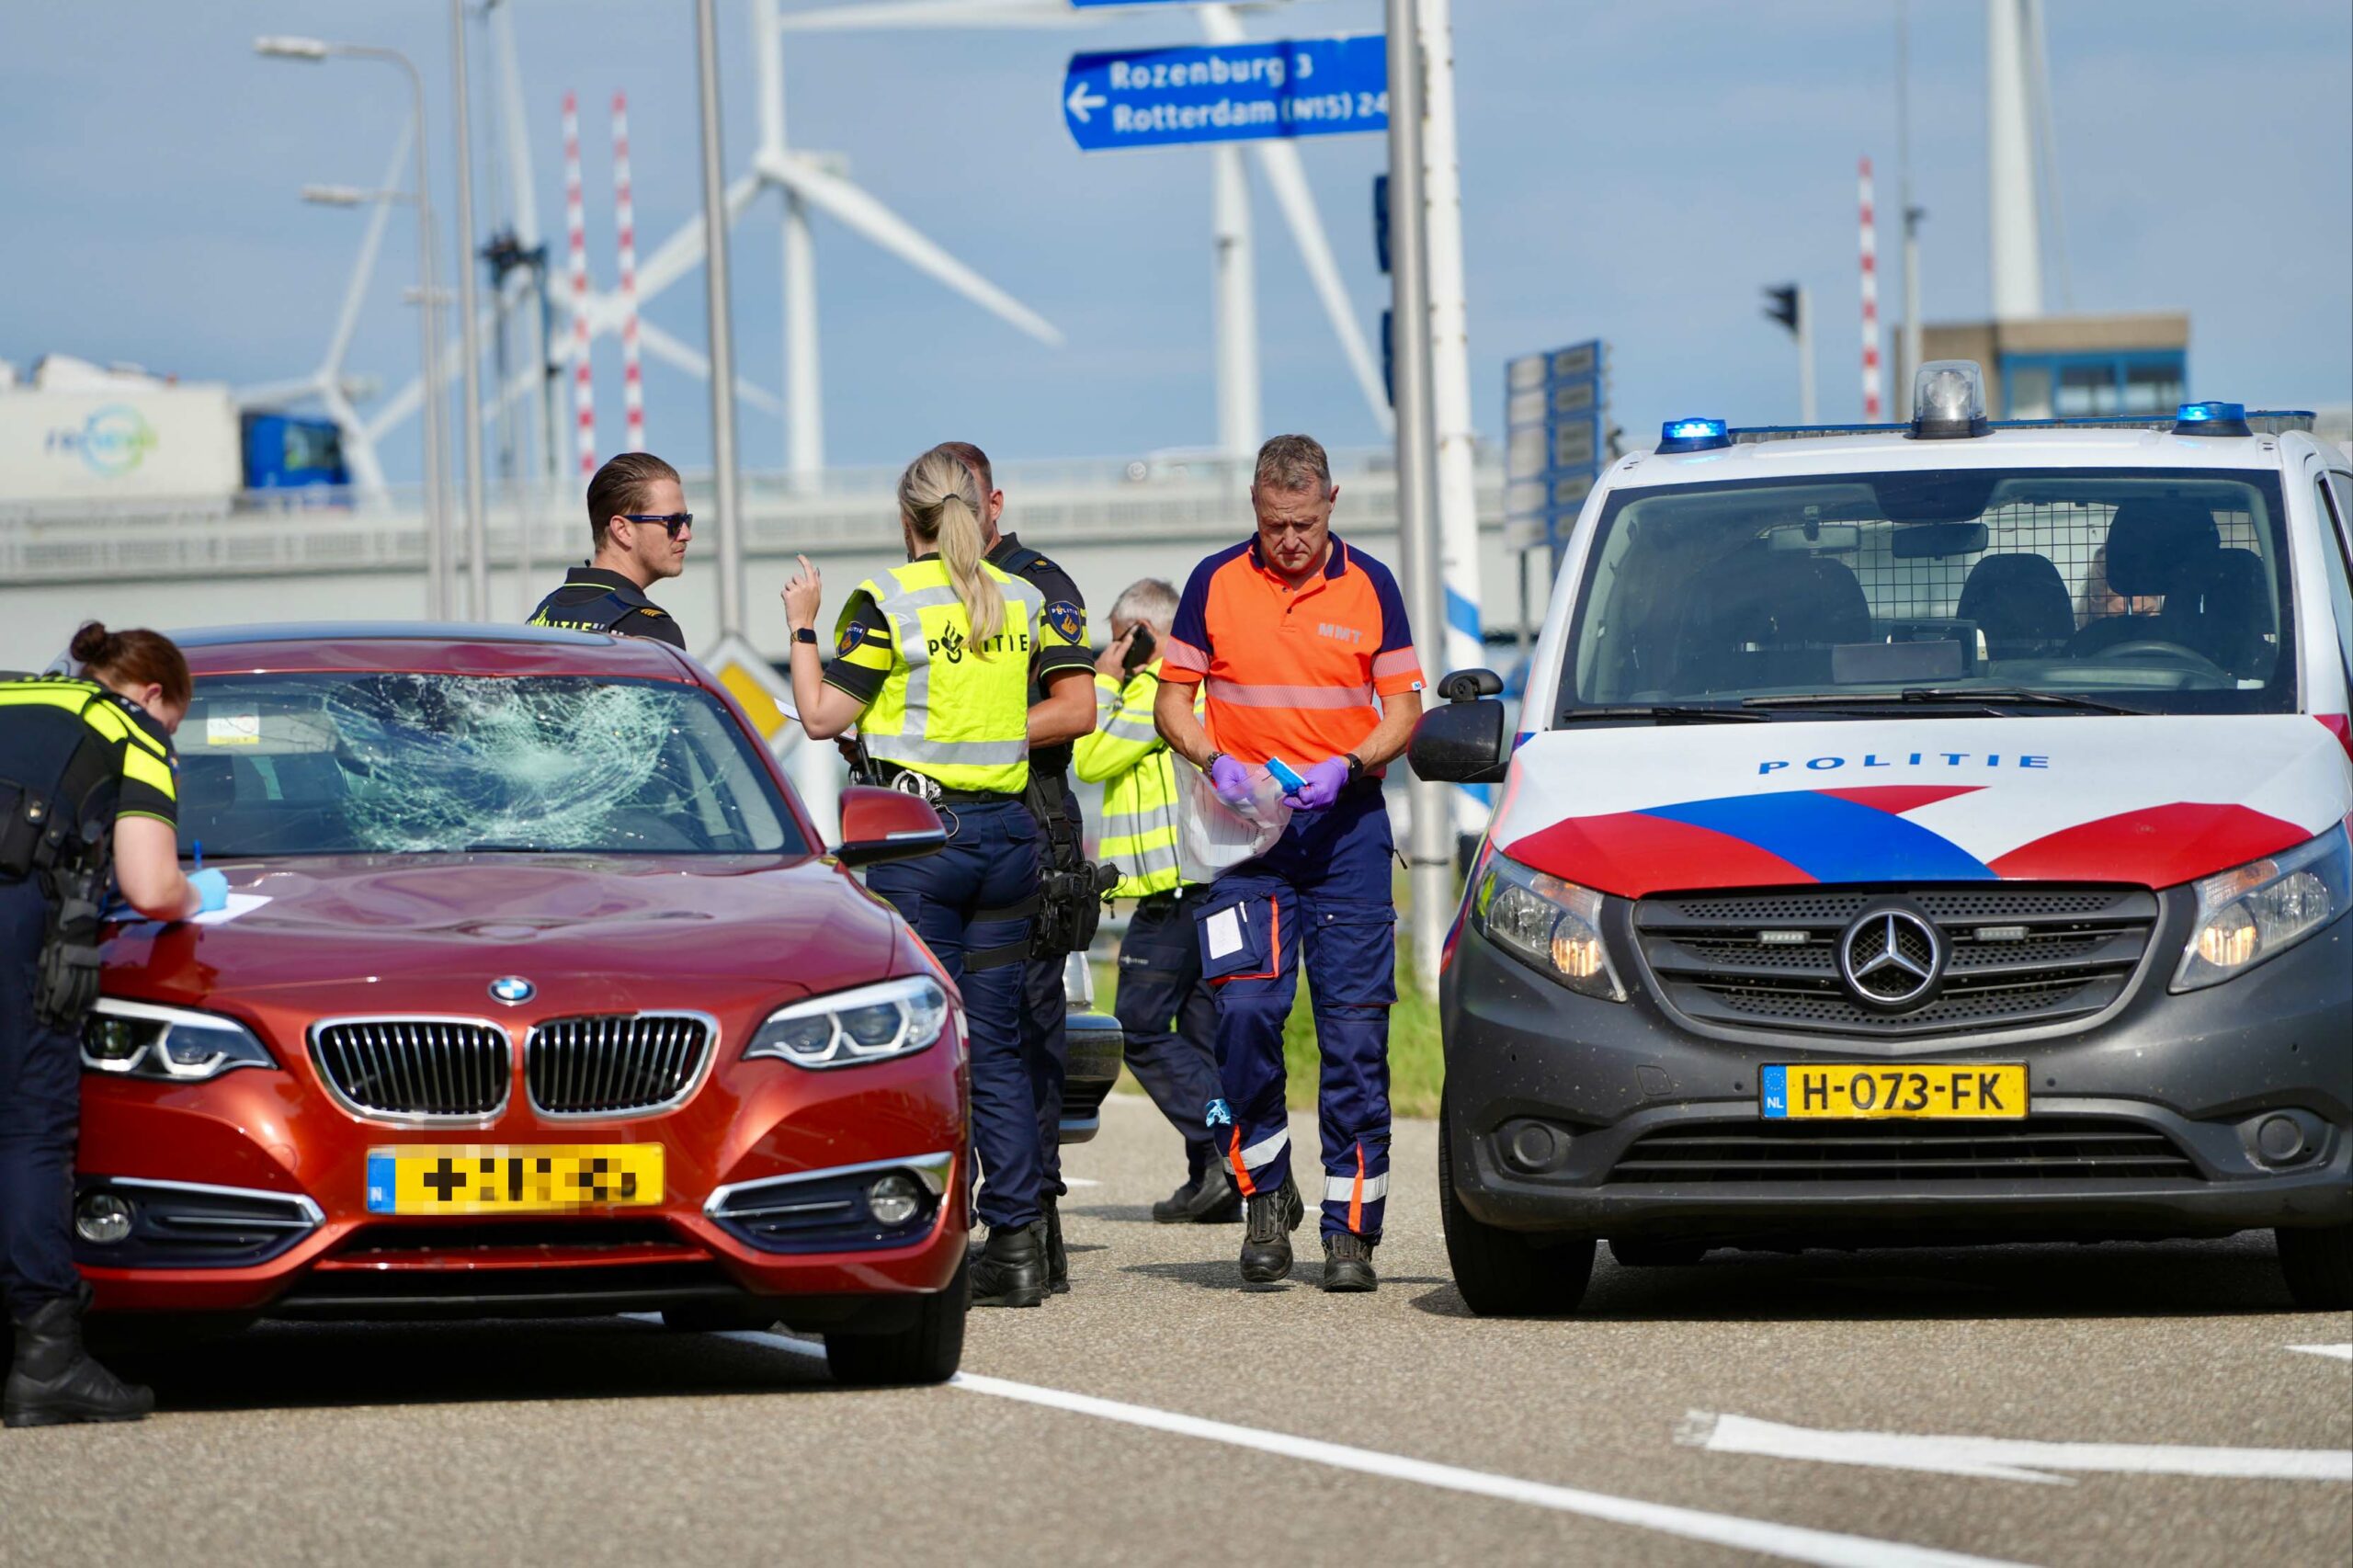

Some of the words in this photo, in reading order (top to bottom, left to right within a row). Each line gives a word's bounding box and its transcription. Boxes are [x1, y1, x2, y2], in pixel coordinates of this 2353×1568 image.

[1109, 56, 1285, 90] Rozenburg
[1295, 52, 1313, 79] 3
[1112, 97, 1278, 132] Rotterdam
[1282, 91, 1354, 121] (N15)
[1317, 622, 1363, 645] MMT
[1757, 752, 2050, 776] POLITIE
[1767, 1097, 1784, 1109] NL
[1802, 1073, 2004, 1110] H-073-FK
